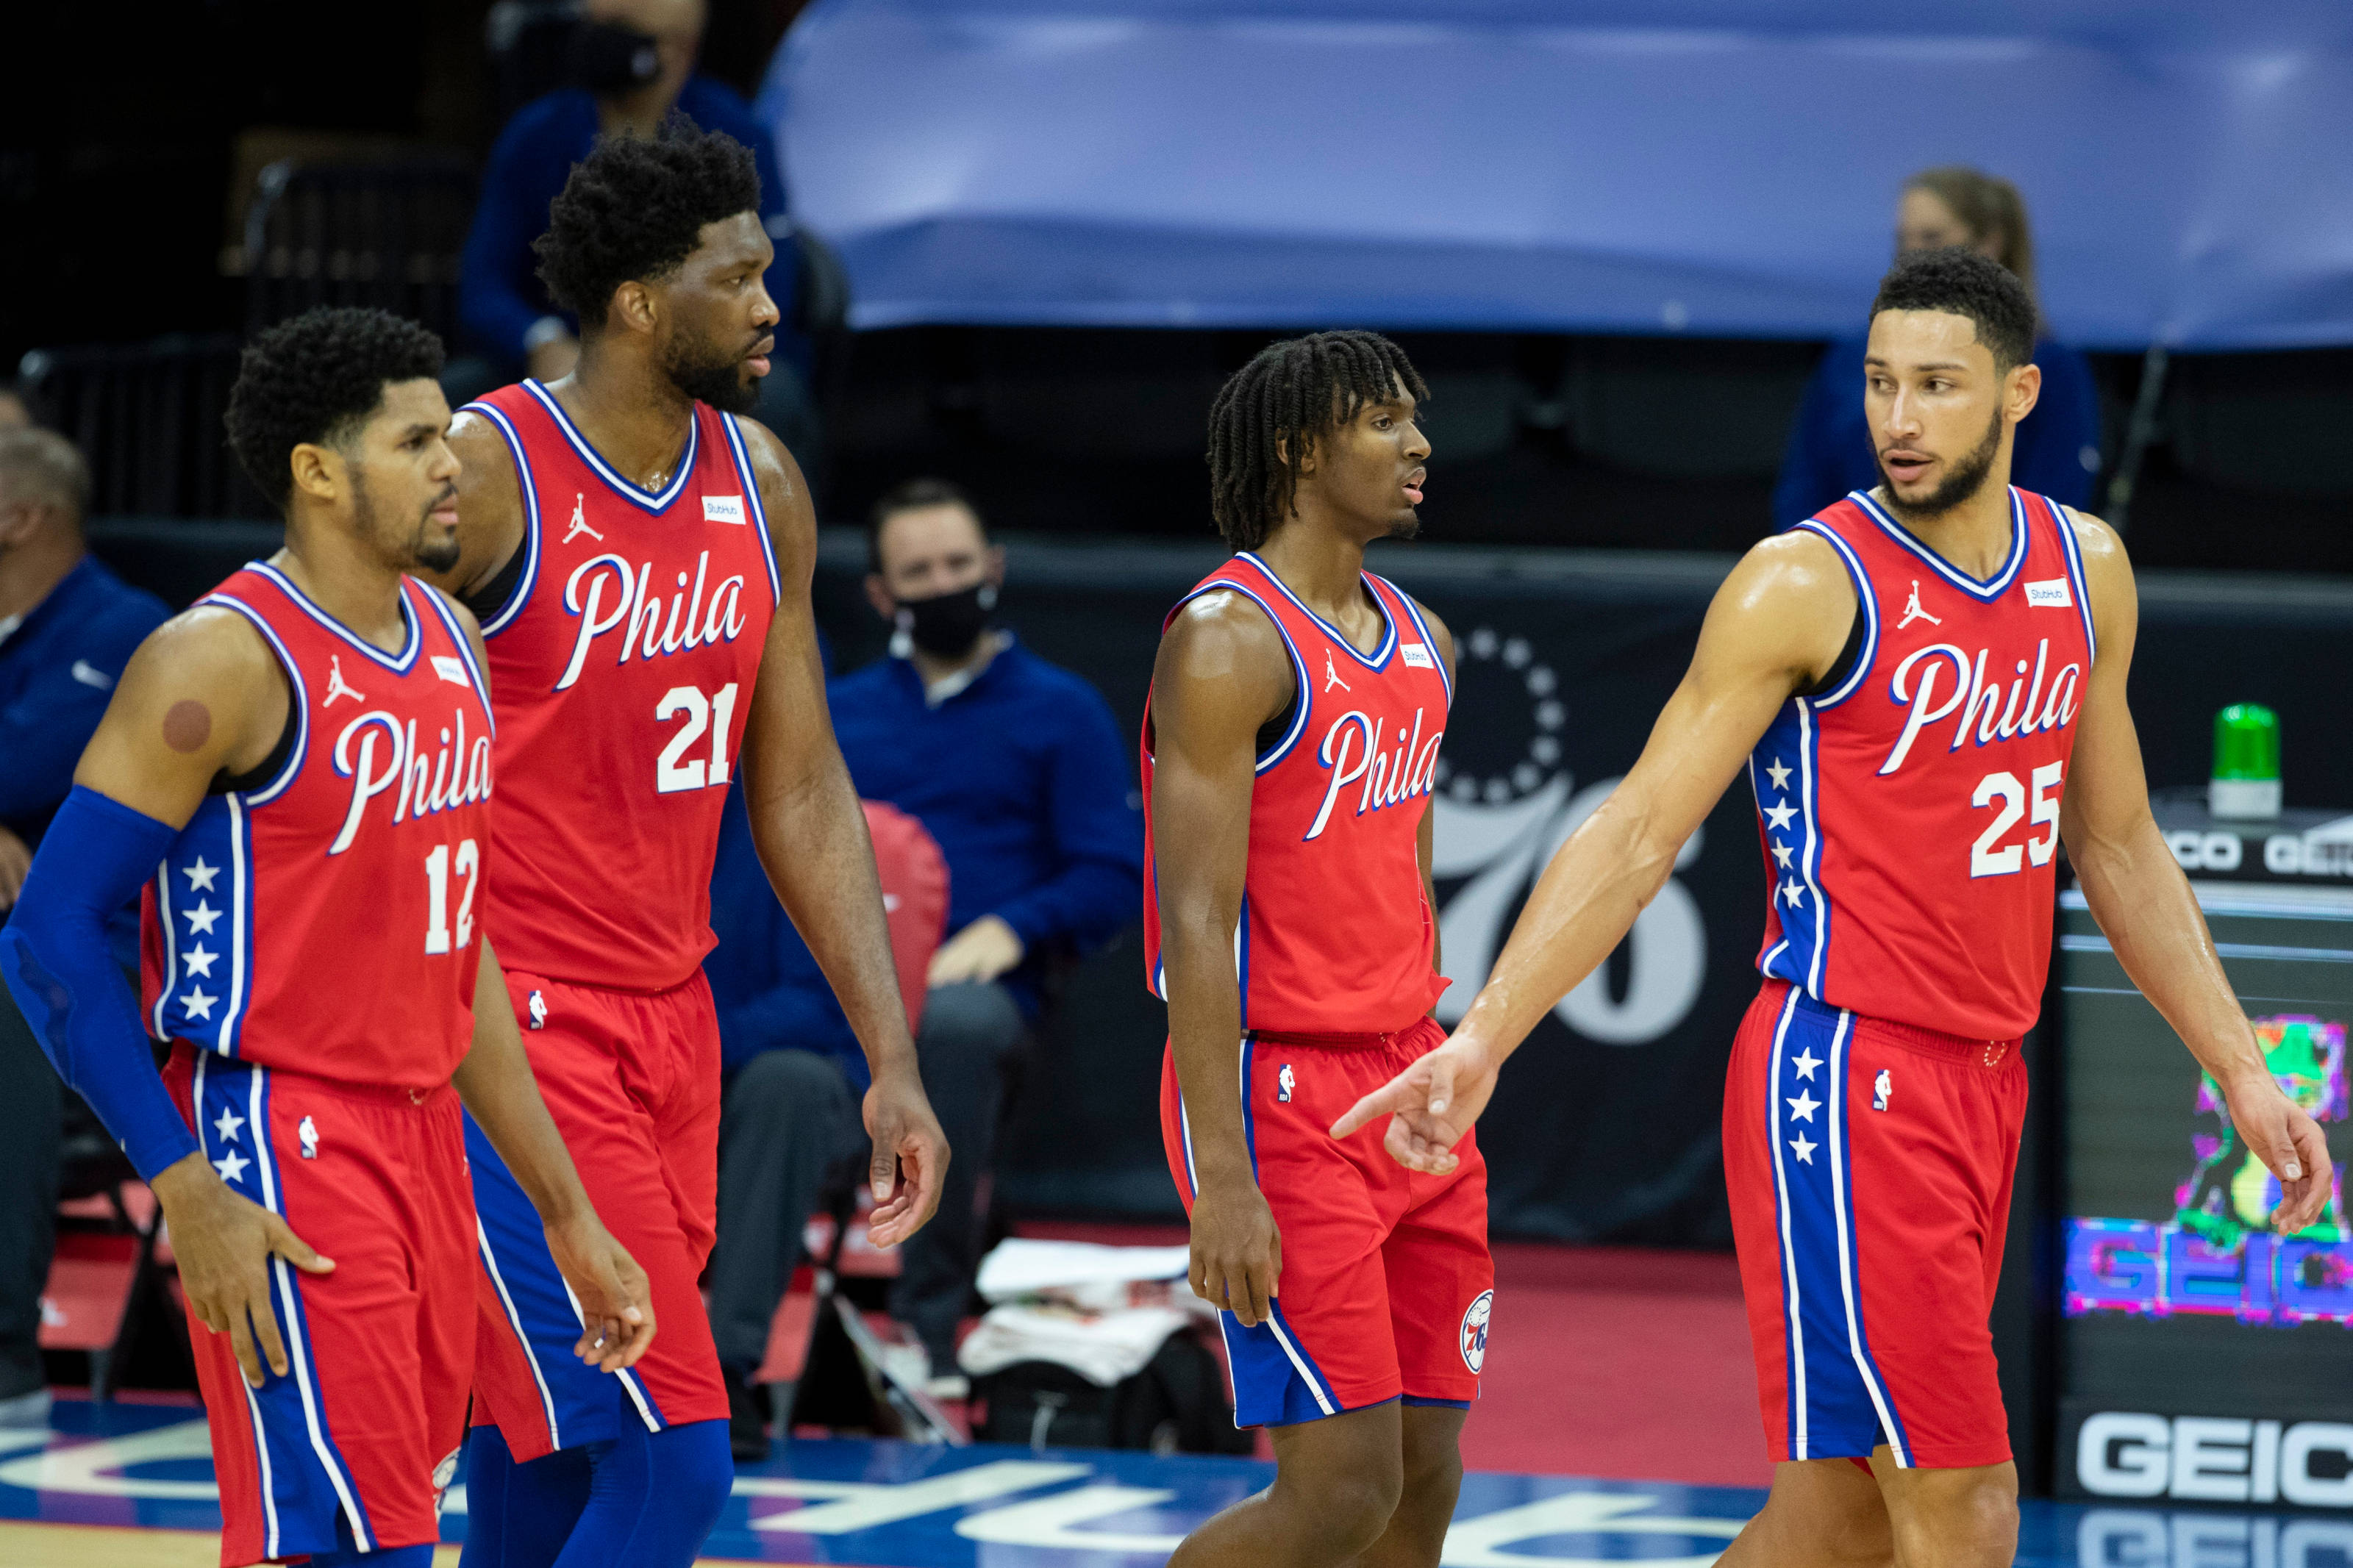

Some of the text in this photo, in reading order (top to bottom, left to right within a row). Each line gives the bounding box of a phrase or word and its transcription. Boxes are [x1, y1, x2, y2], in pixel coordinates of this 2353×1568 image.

[552, 551, 746, 692] Phila
[2031, 589, 2063, 599] StubHub
[655, 683, 738, 793] 21
[1876, 638, 2079, 776] Phila
[327, 708, 493, 856] Phila
[1302, 707, 1443, 842] Phila
[1971, 760, 2063, 878] 25
[425, 839, 479, 955] 12
